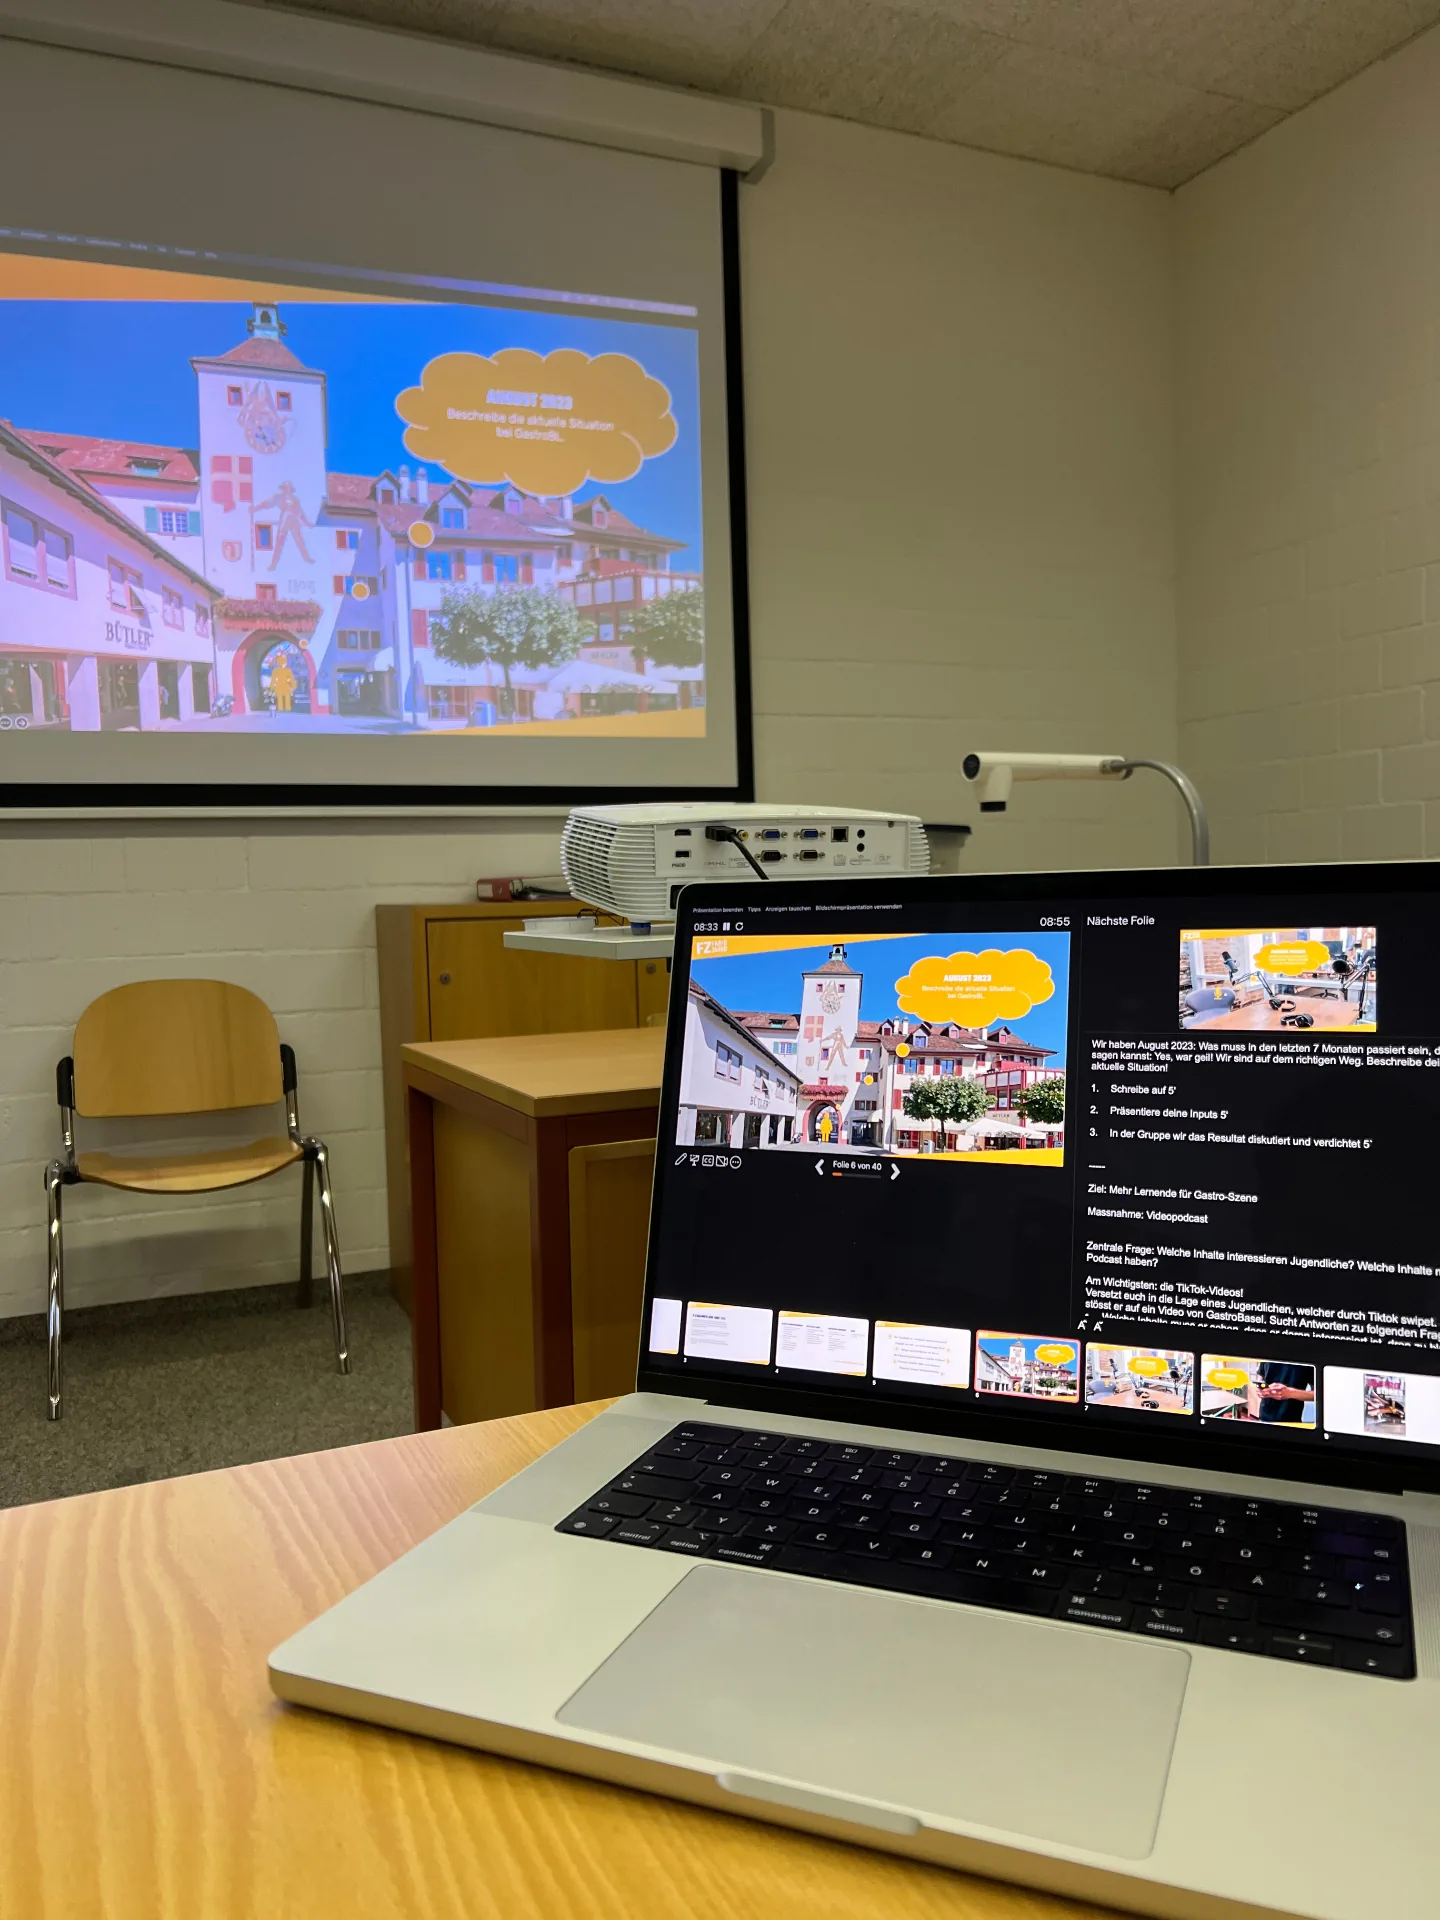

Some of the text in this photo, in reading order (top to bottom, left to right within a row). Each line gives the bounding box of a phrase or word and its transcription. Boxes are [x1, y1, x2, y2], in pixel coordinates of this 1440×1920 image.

[486, 389, 572, 410] AUGUST 2023
[447, 408, 615, 431] Beschreibe die aktuelle Situation
[496, 426, 512, 438] bei
[694, 922, 718, 931] 08:33
[1040, 917, 1070, 926] 08:55
[1087, 916, 1155, 925] Nächste Folie
[696, 942, 711, 954] FZ
[1092, 1040, 1107, 1049] Wir
[1109, 1040, 1136, 1049] haben
[1138, 1041, 1168, 1051] August
[1171, 1042, 1196, 1050] 2023:
[1198, 1042, 1219, 1051] Was
[1248, 1042, 1256, 1051] in
[1259, 1043, 1277, 1052] den
[1279, 1044, 1310, 1052] letzten
[1313, 1044, 1319, 1053] 7
[1322, 1044, 1364, 1054] Monaten
[1366, 1045, 1406, 1056] passiert
[1408, 1046, 1432, 1056] sein,
[1092, 1052, 1118, 1061] sagen
[1120, 1052, 1152, 1060] kannst:
[1154, 1053, 1173, 1062] Yes,
[1194, 1054, 1213, 1063] geil!
[1216, 1054, 1231, 1062] Wir
[1234, 1054, 1253, 1062] sind
[1255, 1055, 1270, 1063] auf
[1273, 1055, 1293, 1064] dem
[1296, 1055, 1336, 1066] richtigen
[1338, 1056, 1364, 1067] Weg.
[1366, 1057, 1422, 1066] Beschreibe
[1091, 1062, 1168, 1072] aktuelle Situation!
[1091, 1084, 1099, 1093] 1.
[1110, 1084, 1149, 1094] Schreibe
[1152, 1086, 1166, 1095] auf
[1090, 1106, 1098, 1114] 2.
[1110, 1106, 1160, 1117] Präsentiere
[1163, 1108, 1188, 1118] deine
[1190, 1109, 1218, 1120] Inputs
[1090, 1127, 1098, 1137] 3.
[1110, 1128, 1118, 1138] In
[1120, 1129, 1135, 1138] der
[1137, 1130, 1171, 1141] Gruppe
[1173, 1132, 1186, 1141] wir
[1188, 1132, 1205, 1141] das
[1208, 1133, 1245, 1143] Resultat
[1248, 1135, 1290, 1145] diskutiert
[1293, 1137, 1311, 1146] und
[1313, 1138, 1361, 1148] verdichtet
[1088, 1184, 1257, 1202] Ziel: Mehr Lernende für Gastro-Szene
[1088, 1207, 1208, 1223] Massnahme: Videopodcast
[1086, 1253, 1158, 1267] Podcast haben?
[1087, 1241, 1123, 1252] Zentrale
[1126, 1244, 1154, 1255] Frage:
[1157, 1246, 1190, 1258] Welche
[1194, 1249, 1224, 1260] Inhalte
[1227, 1252, 1287, 1264] interessieren
[1290, 1256, 1354, 1269] Jugendliche?
[1357, 1260, 1394, 1272] Welche
[1398, 1264, 1432, 1276] Inhalte
[1086, 1276, 1244, 1298] Am Wichtigsten: die TikTok-Videos!
[1086, 1288, 1437, 1327] Versetzt euch in die Lage eines Jugendlichen, welcher durch Tiktok swipet.
[1085, 1300, 1111, 1310] stösst
[1125, 1303, 1140, 1312] auf
[1142, 1305, 1156, 1314] ein
[1158, 1306, 1184, 1317] Video
[1186, 1309, 1203, 1318] von
[1206, 1311, 1266, 1324] GastroBasel.
[1270, 1316, 1297, 1327] Sucht
[1299, 1319, 1349, 1332] Antworten
[1352, 1325, 1363, 1333] zu
[1367, 1324, 1418, 1337] folgenden
[619, 1531, 651, 1540] control
[765, 1525, 777, 1533] X
[670, 1540, 699, 1550] option
[718, 1548, 763, 1561] command
[1032, 1568, 1046, 1577] M
[1067, 1608, 1122, 1622] command
[1146, 1622, 1183, 1634] option
